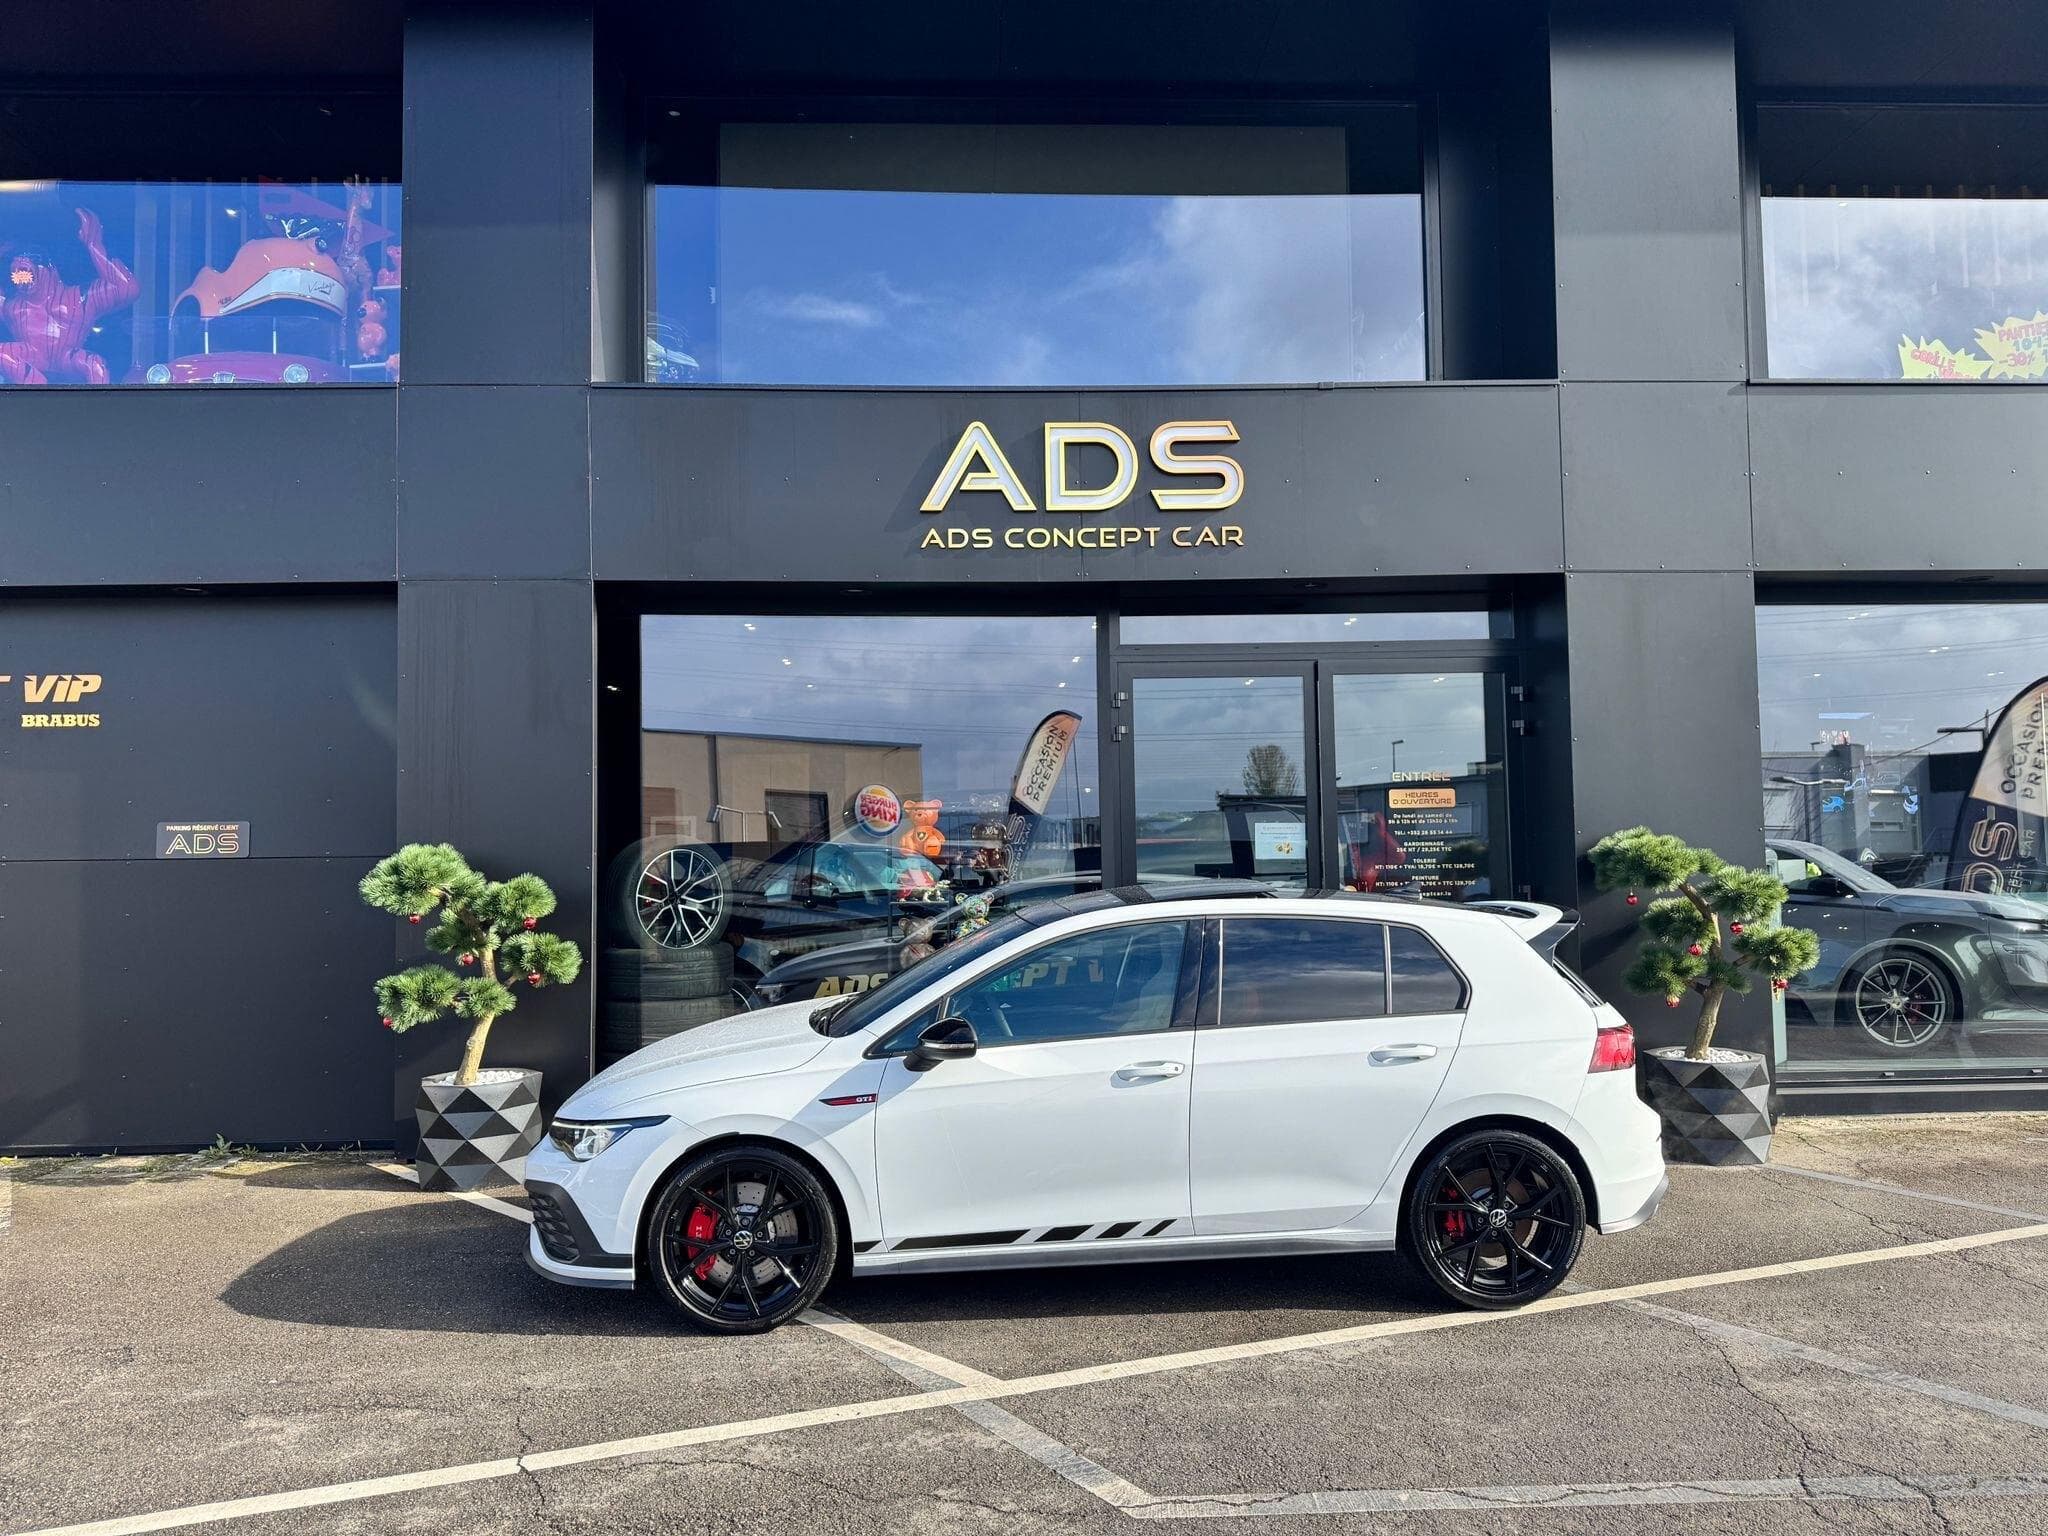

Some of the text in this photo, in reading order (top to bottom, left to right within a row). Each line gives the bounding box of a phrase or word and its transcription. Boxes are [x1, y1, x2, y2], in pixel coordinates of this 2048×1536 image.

[919, 420, 1245, 511] ADS
[920, 525, 1245, 549] ADS CONCEPT CAR
[21, 713, 100, 727] BRABUS
[1025, 723, 1059, 796] OCCASION
[1033, 730, 1068, 802] PREMIUM
[1392, 798, 1452, 806] D'OUVERTURE
[1405, 791, 1439, 799] HEURES
[191, 823, 219, 831] RÉSERVÉ
[165, 832, 240, 855] ADS
